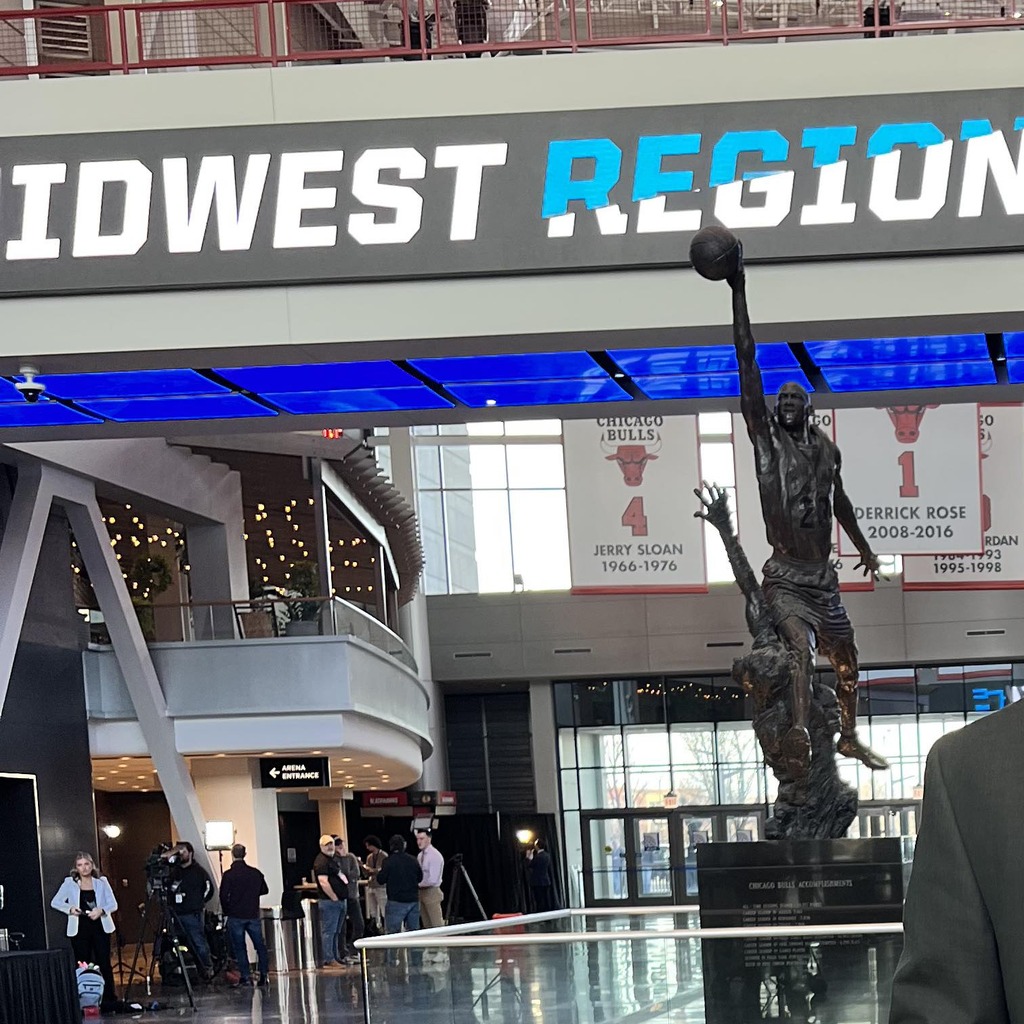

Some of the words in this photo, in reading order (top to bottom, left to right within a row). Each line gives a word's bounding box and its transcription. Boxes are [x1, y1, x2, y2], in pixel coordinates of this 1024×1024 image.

[0, 143, 508, 260] IDWEST
[597, 416, 664, 427] CHICAGO
[607, 429, 655, 441] BULLS
[897, 451, 919, 497] 1
[621, 496, 648, 536] 4
[855, 506, 920, 520] DERRICK
[926, 506, 966, 519] ROSE
[868, 526, 953, 539] 2008-2016
[985, 535, 1019, 546] RDAN
[594, 544, 632, 556] JERRY
[637, 543, 683, 555] SLOAN
[601, 560, 678, 572] 1966-1976
[934, 562, 1002, 573] 1995-1998
[282, 772, 319, 780] ENTRANCE
[748, 882, 775, 890] CHICAGO
[777, 881, 795, 889] BULLS
